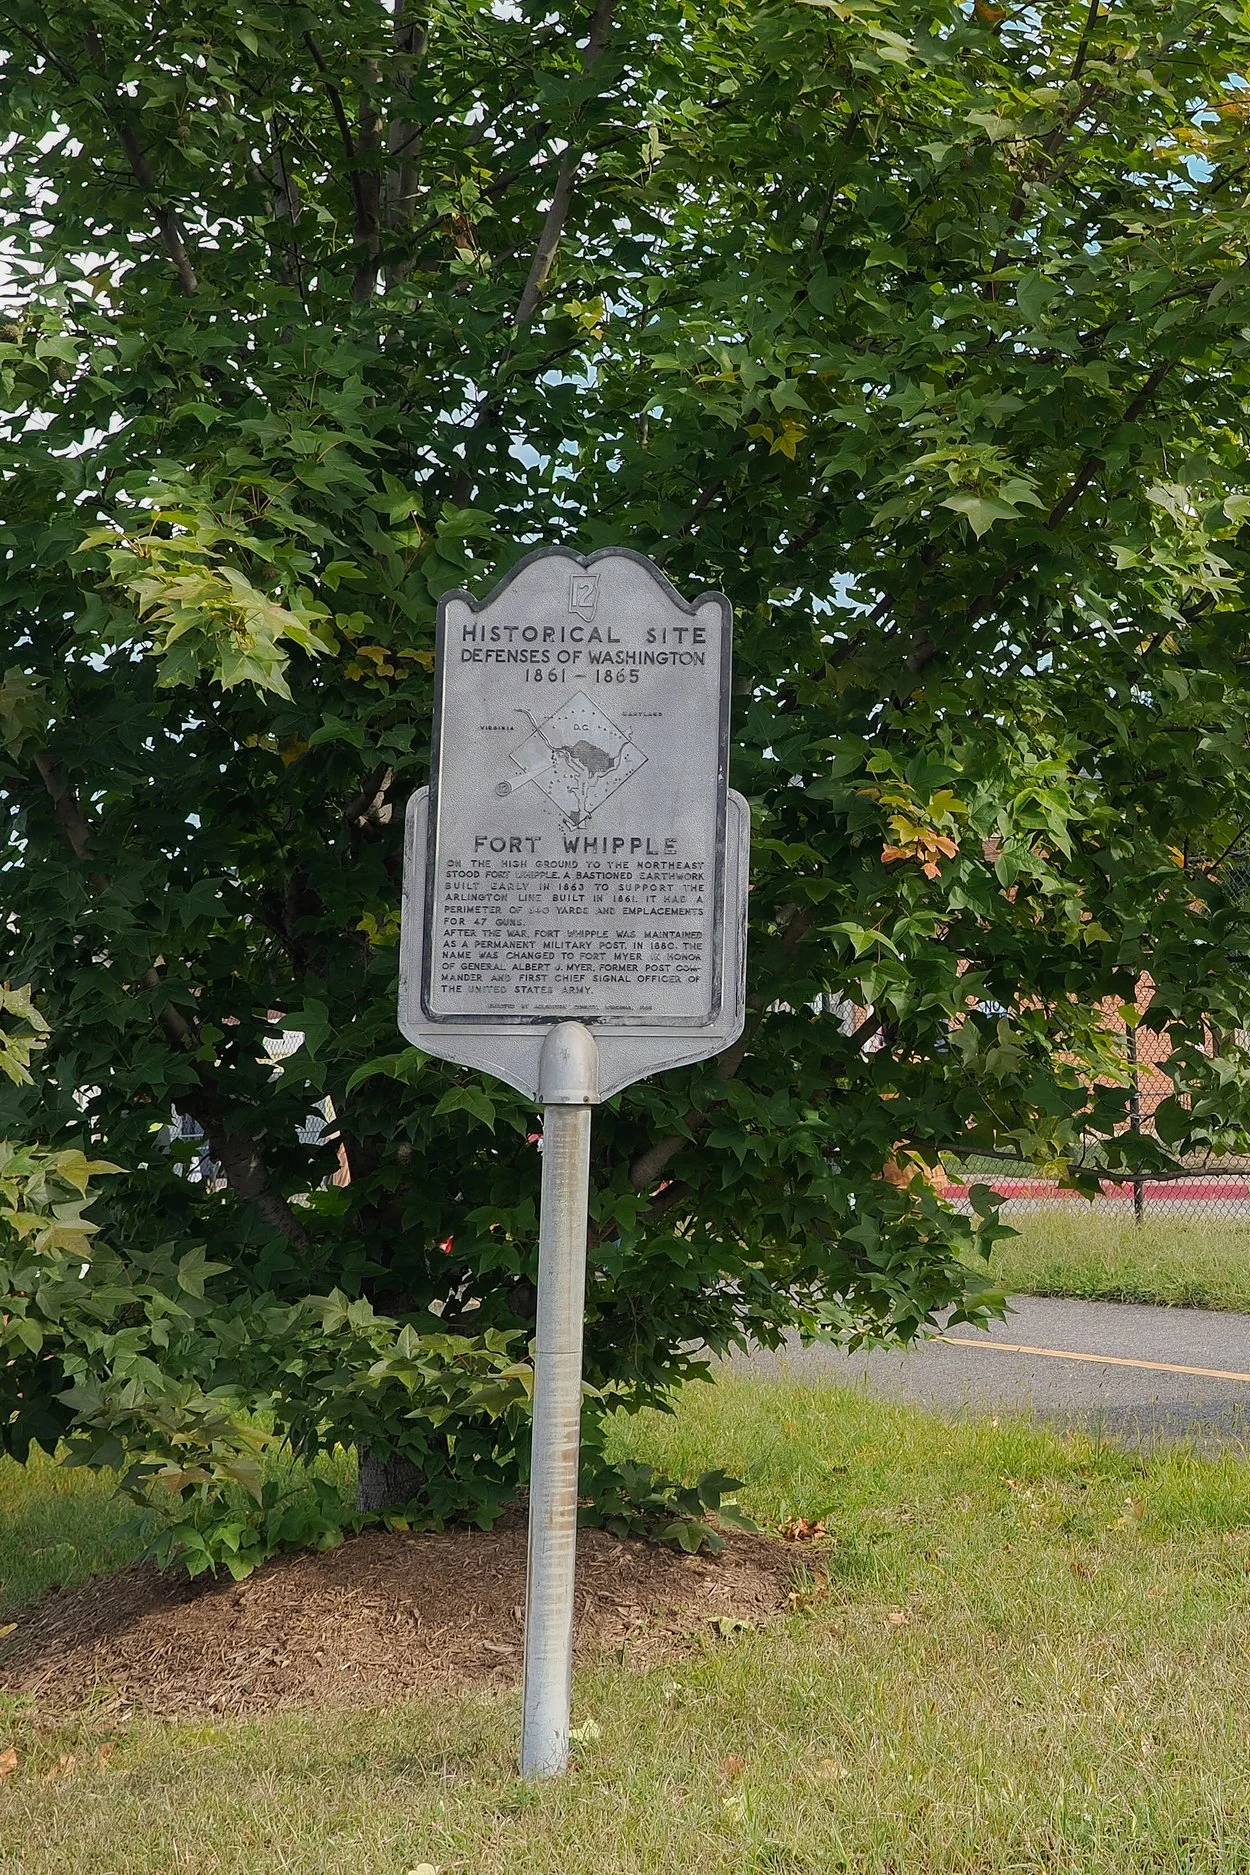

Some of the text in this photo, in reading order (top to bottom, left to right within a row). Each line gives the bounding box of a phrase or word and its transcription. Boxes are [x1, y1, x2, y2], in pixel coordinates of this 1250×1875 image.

[572, 580, 595, 607] 12
[462, 625, 707, 644] HISTORICAL SITE
[461, 649, 705, 665] DEFENSES OF WASHINGTON
[474, 836, 678, 855] FORT WHIPPLE
[447, 860, 704, 870] ON THE HIGH GROUND TO THE NORTHEAST
[446, 871, 480, 879] STOOD
[485, 871, 511, 879] FORT
[563, 872, 571, 880] A
[576, 872, 633, 880] BASTIONED
[640, 872, 705, 881] EARTHWORK
[445, 882, 479, 890] BUILT
[491, 882, 529, 890] EARLY
[539, 883, 550, 891] IN
[558, 883, 584, 891] 1863
[619, 884, 674, 892] SUPPORT
[683, 884, 705, 892] THE
[445, 893, 508, 901] ARLINGTON
[552, 894, 585, 902] BUILT
[444, 906, 502, 914] PERIMETER
[509, 906, 523, 914] OF
[556, 906, 589, 915] YARDS
[595, 907, 616, 915] AND
[623, 907, 704, 916] EMPLACEMENTS
[443, 917, 526, 927] FOR 47 GUNS.
[443, 929, 477, 937] AFTER
[481, 929, 502, 937] THE
[534, 929, 560, 938] FORT
[567, 930, 609, 938] WHIPPLE
[616, 930, 636, 938] WAS
[644, 931, 703, 939] MAINTAINED
[443, 940, 456, 948] AS
[474, 940, 535, 949] PERMANENT
[543, 941, 592, 949] MILITARY
[633, 942, 643, 950] IN
[683, 942, 703, 950] THE
[442, 951, 472, 959] NAME
[479, 951, 499, 959] WAS
[506, 951, 555, 959] CHANGED
[580, 952, 606, 960] FORT
[614, 952, 642, 960] MYER
[667, 953, 702, 961] HONOR
[442, 962, 455, 970] OF
[461, 962, 506, 971] GENERAL
[512, 963, 550, 971] ALBERT
[555, 963, 563, 971] J.
[600, 963, 639, 972] FORMER
[645, 964, 671, 972] POST
[676, 964, 702, 972] COM-
[441, 973, 701, 983] MANDER AND FIRST CHIEF SIGNAL OFFICER OF
[441, 985, 594, 994] THE UNITED STATES ARMY.
[984, 1000, 1001, 1012] NO
